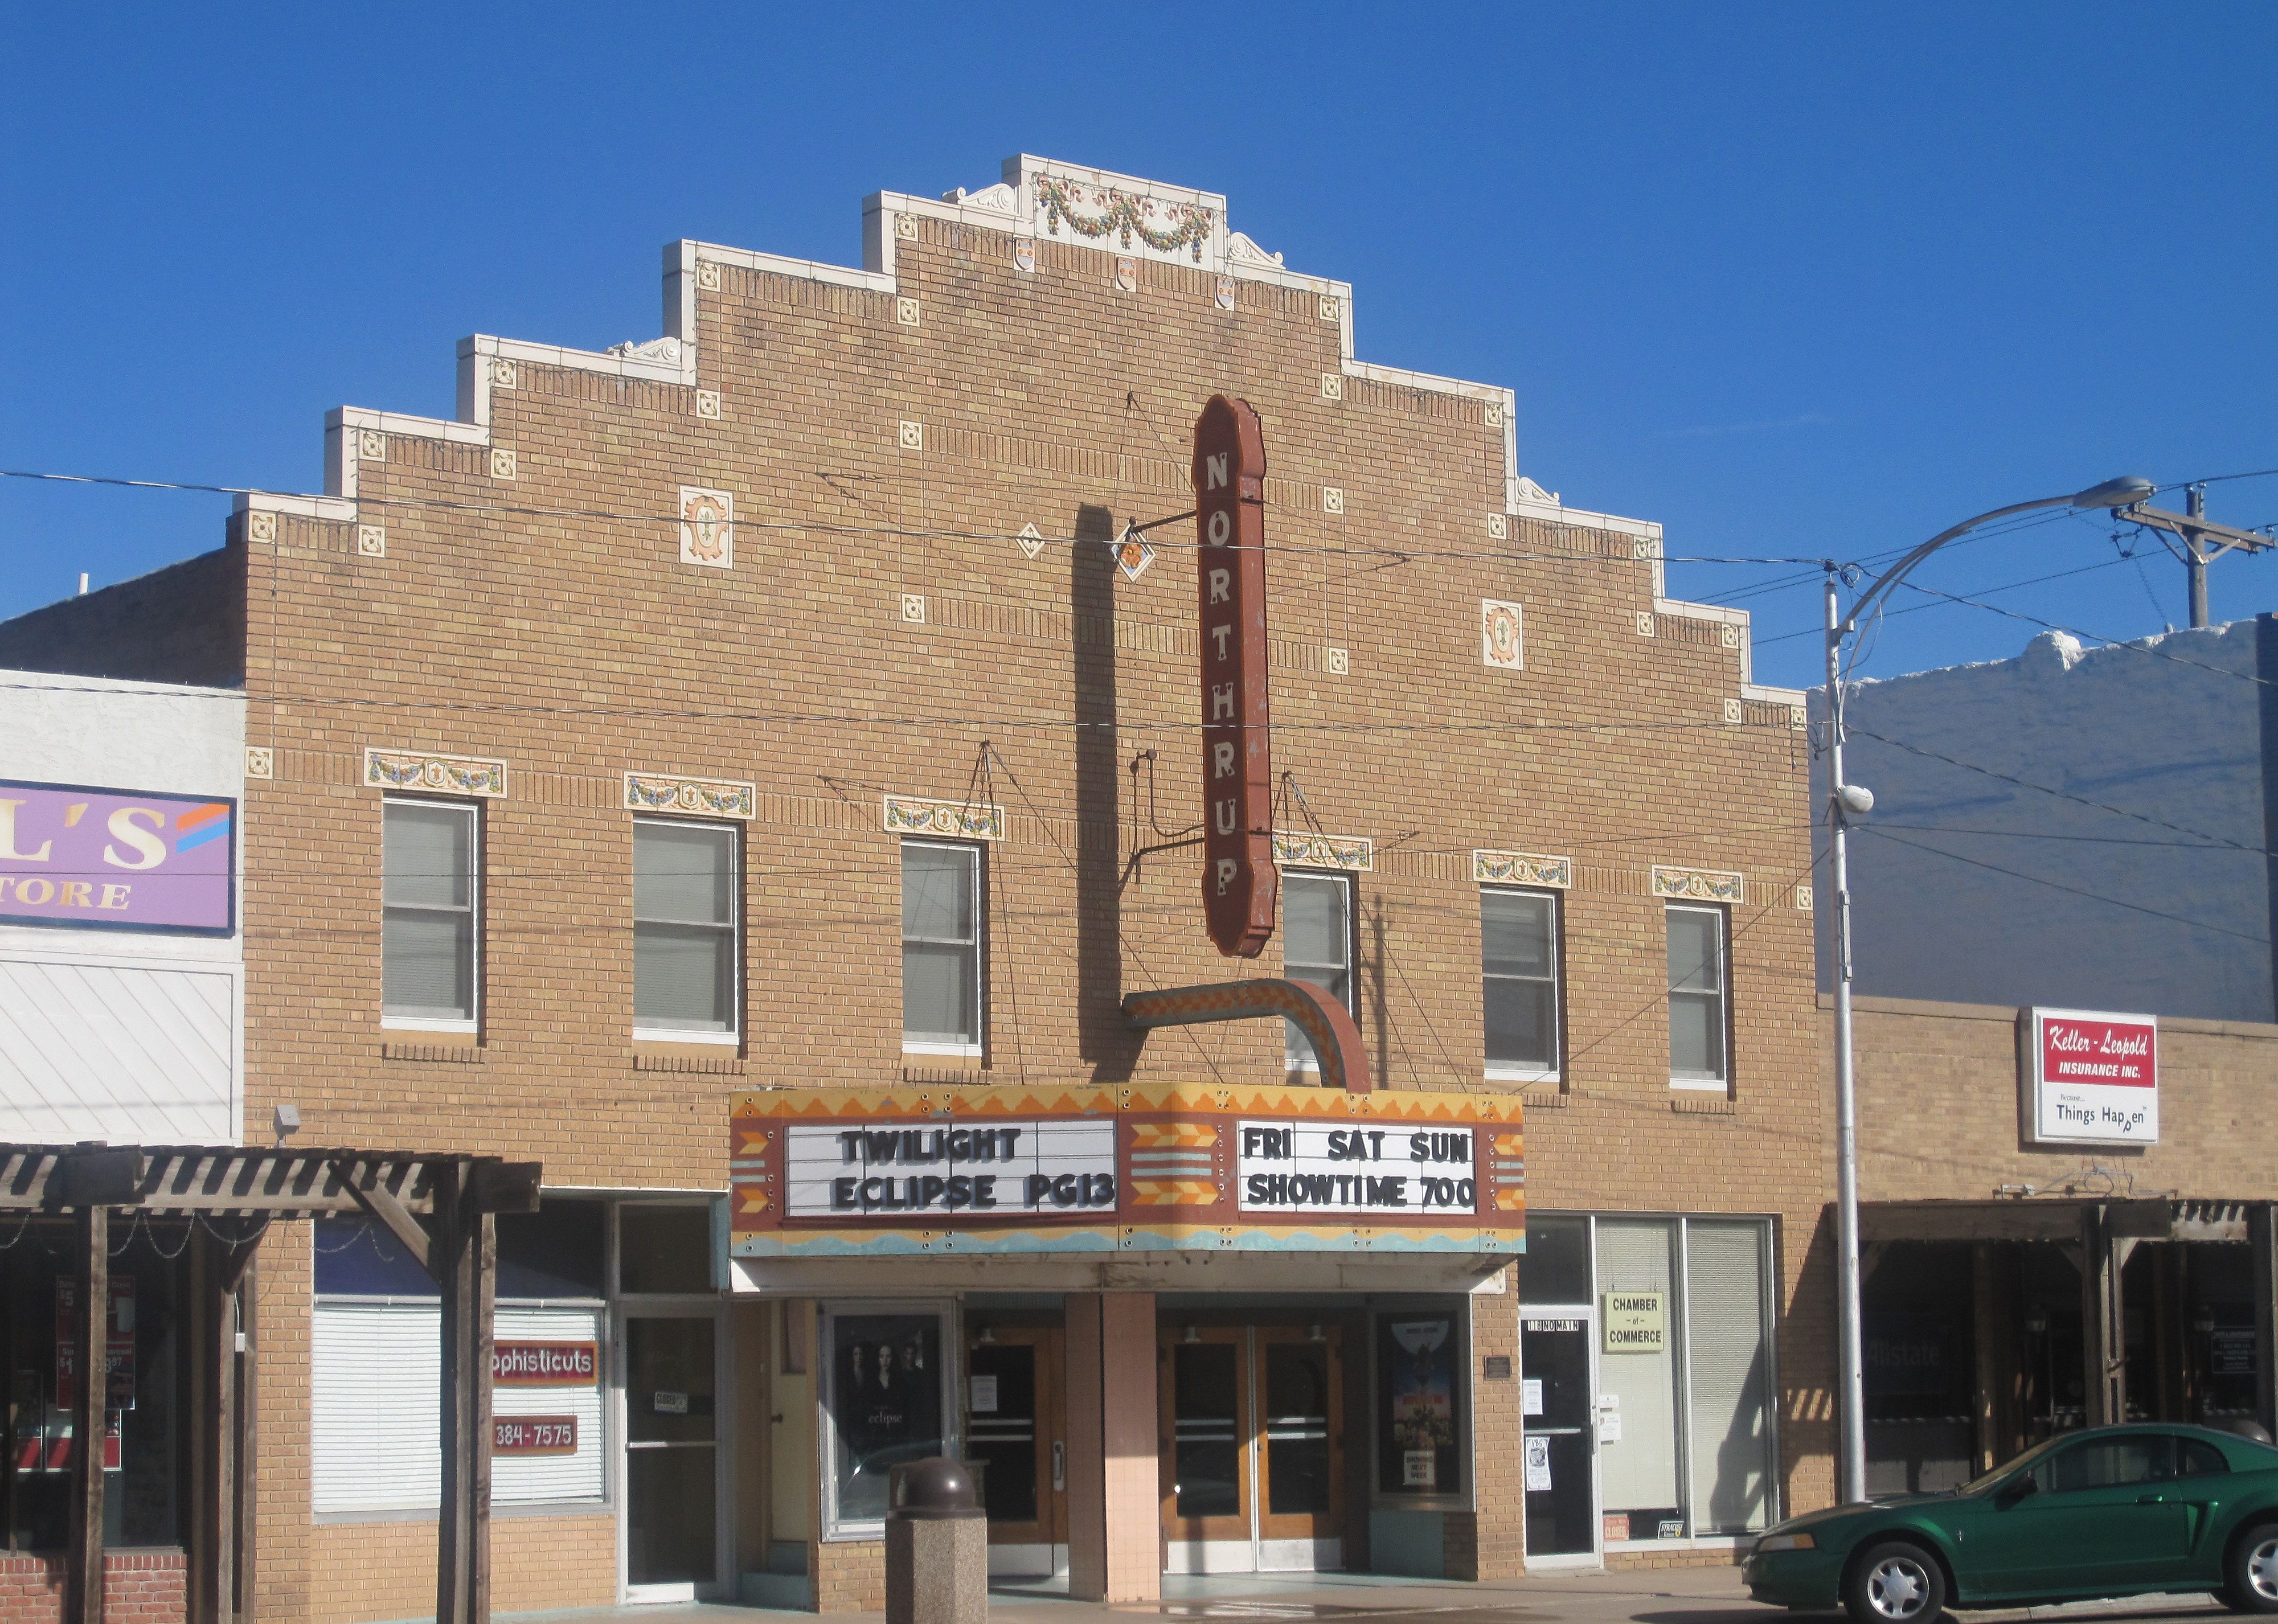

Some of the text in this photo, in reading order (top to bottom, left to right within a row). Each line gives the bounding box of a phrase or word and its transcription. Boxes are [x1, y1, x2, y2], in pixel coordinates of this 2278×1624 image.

[1207, 452, 1237, 897] NORTHRUP
[2050, 1026, 2091, 1052] Keller
[2100, 1029, 2148, 1061] Leopold
[2059, 1061, 2141, 1078] INSURANCE INC.
[2056, 1104, 2095, 1125] Things
[2102, 1106, 2144, 1133] Happen
[841, 1128, 1021, 1163] TWILIGHT
[1244, 1127, 1468, 1164] FRI SAT SUN
[834, 1173, 1115, 1208] ECLIPSE PG13
[1247, 1174, 1476, 1208] SHOWTIME 700
[1613, 1298, 1658, 1311] CHAMBER
[1544, 1320, 1555, 1331] NO
[1556, 1320, 1579, 1331] MAIN
[1609, 1330, 1662, 1343] COMMERCE
[1867, 1340, 1940, 1367] Allstate
[868, 1410, 903, 1428] eclipse
[496, 1424, 572, 1446] 384-7575
